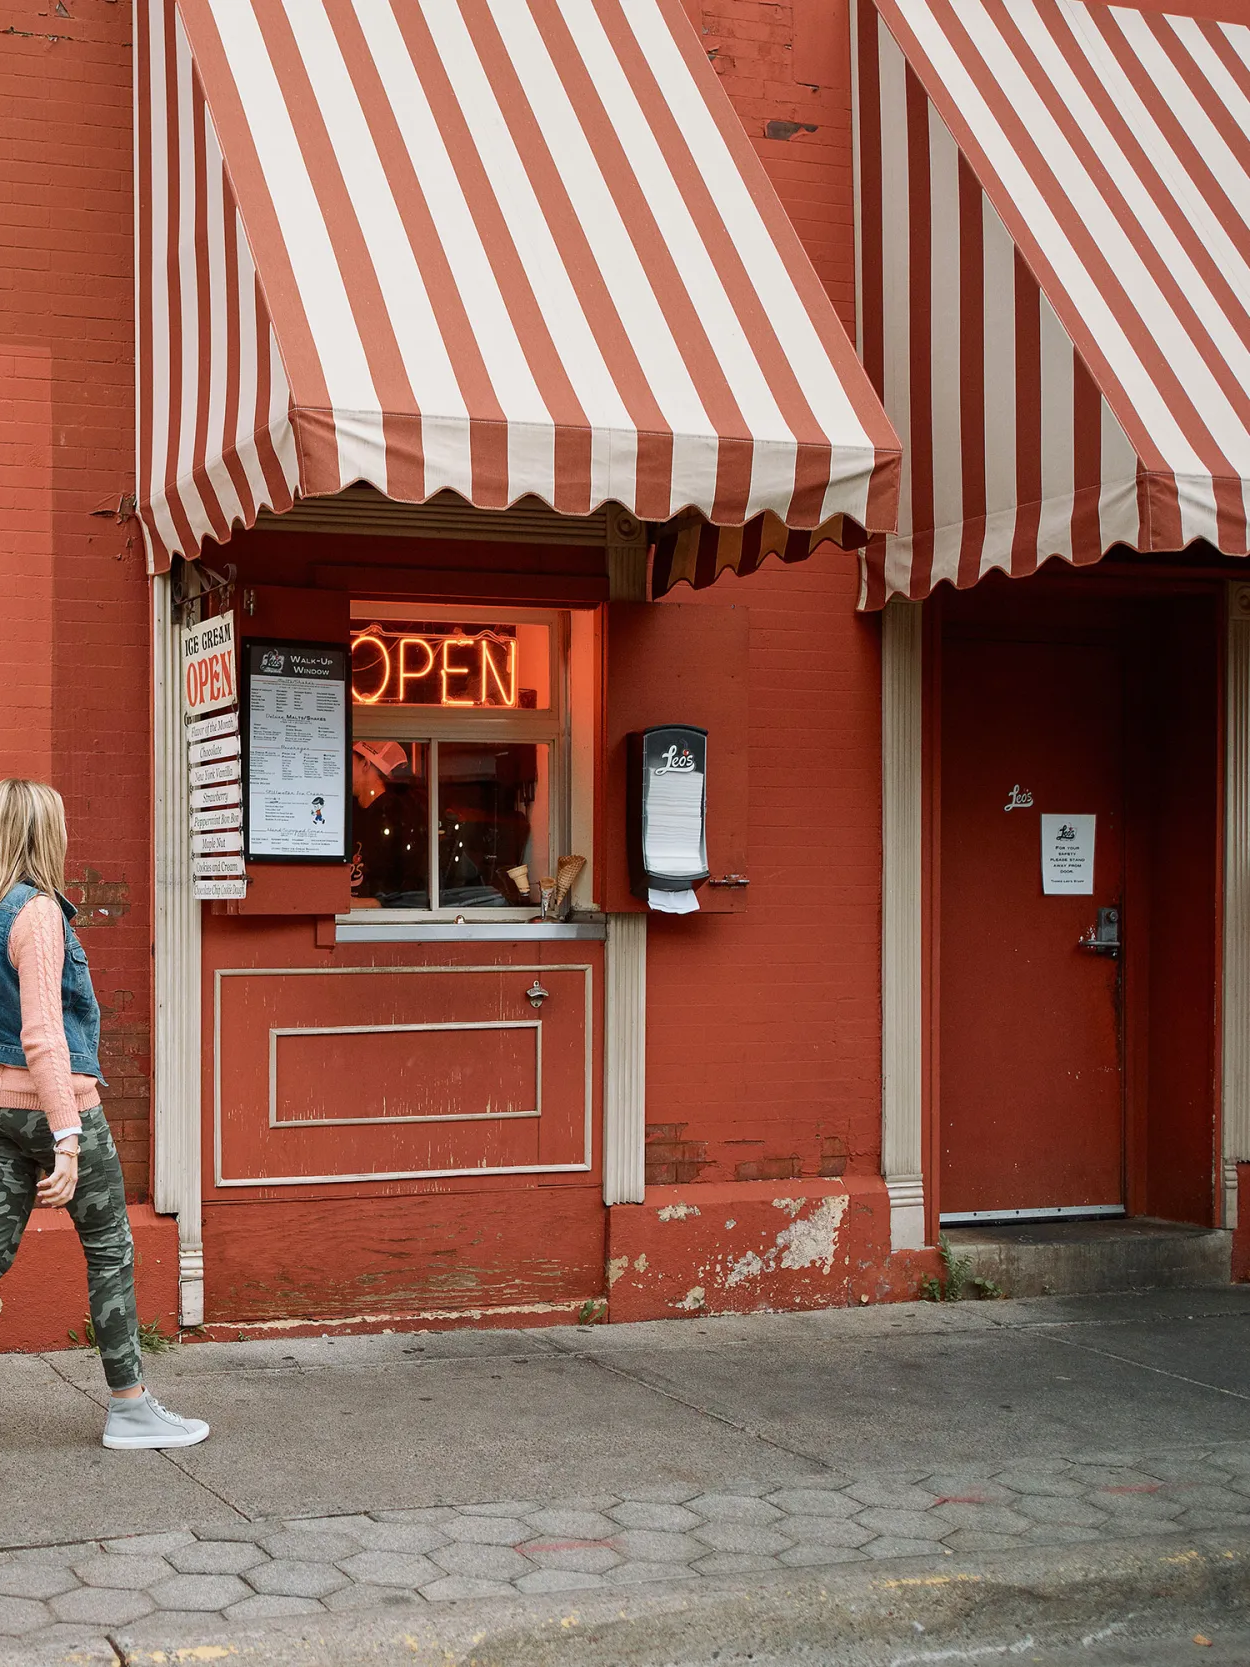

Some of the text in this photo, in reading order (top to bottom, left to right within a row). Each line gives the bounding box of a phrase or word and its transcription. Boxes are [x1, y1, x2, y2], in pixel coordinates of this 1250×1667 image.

[184, 623, 232, 657] ICE CREAM
[186, 649, 233, 707] OPEN
[351, 636, 516, 706] OPEN
[191, 725, 205, 738] Flavor
[217, 716, 234, 731] Month
[199, 744, 223, 758] Chocolate
[655, 745, 695, 776] Leo's
[204, 768, 216, 781] York
[202, 790, 229, 804] Strawberry
[193, 813, 221, 829] Peppermint
[202, 837, 226, 851] Maple Nut
[196, 860, 238, 872] Cookies and Cream
